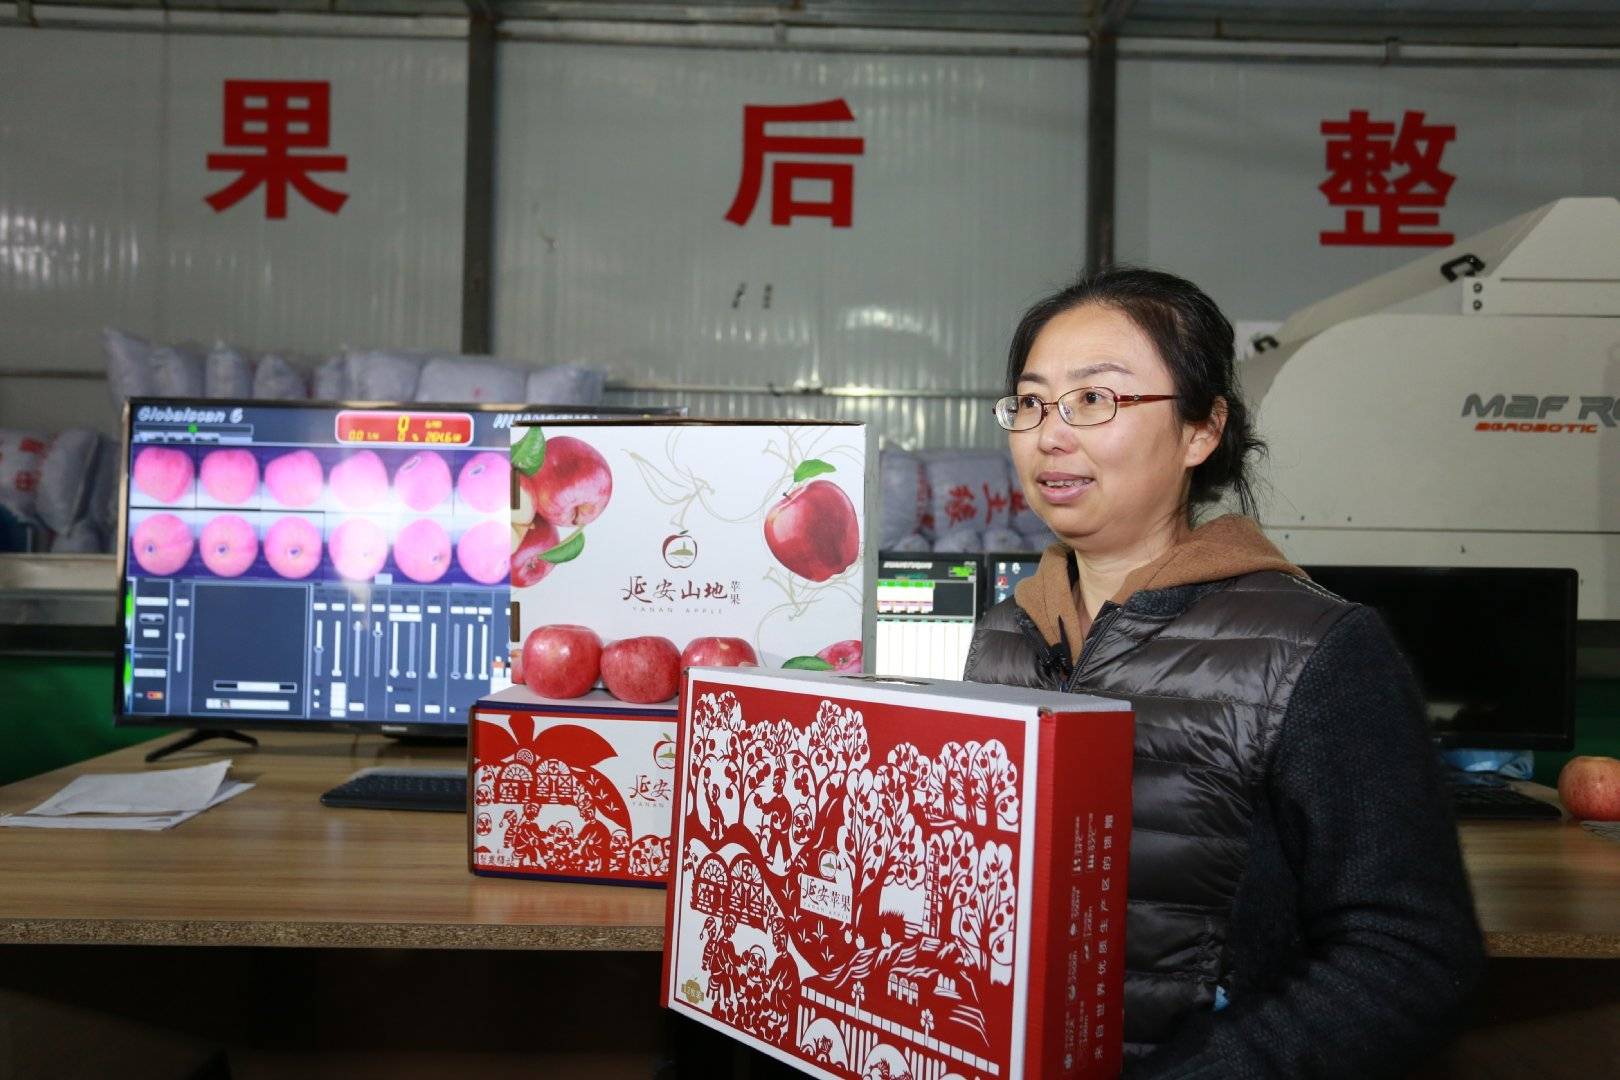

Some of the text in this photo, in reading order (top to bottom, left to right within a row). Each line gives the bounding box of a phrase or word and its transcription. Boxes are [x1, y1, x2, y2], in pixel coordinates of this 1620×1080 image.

[206, 80, 1456, 246] 果 后 整
[621, 575, 728, 603] 延安山地
[627, 774, 672, 802] 延安
[801, 877, 851, 912] 延安苹果
